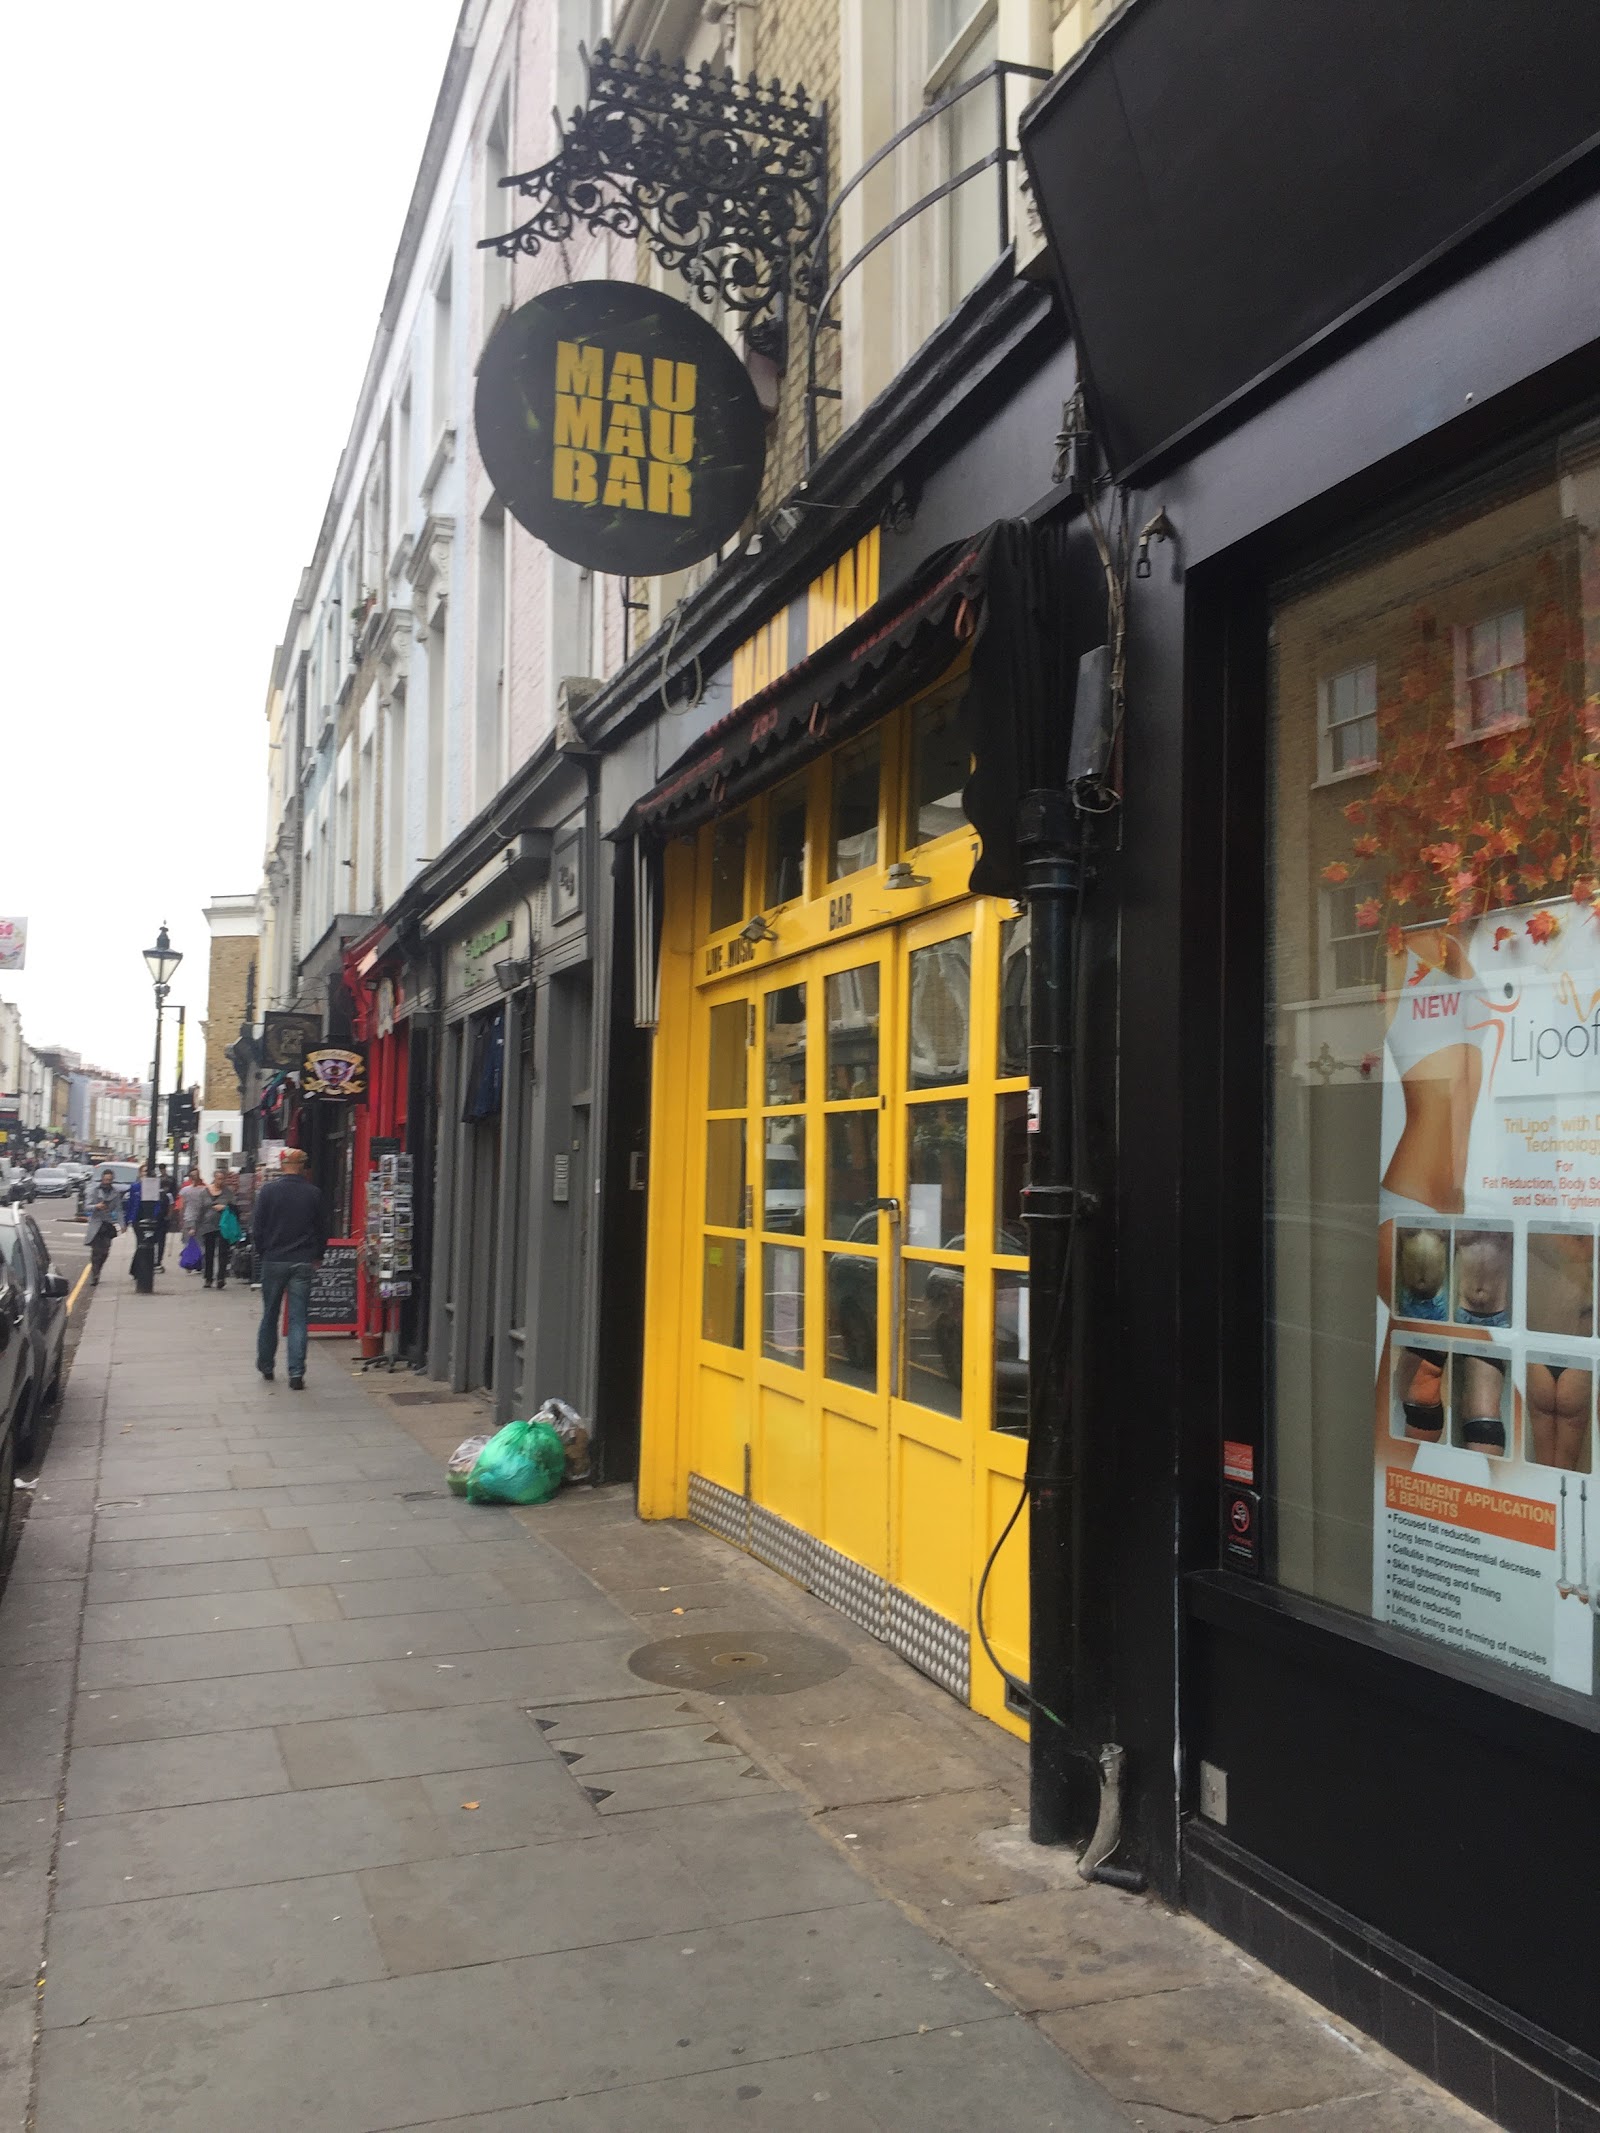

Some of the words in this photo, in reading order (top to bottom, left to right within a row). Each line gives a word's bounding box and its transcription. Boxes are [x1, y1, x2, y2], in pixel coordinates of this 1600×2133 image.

[556, 341, 697, 412] MAU
[553, 393, 695, 464] MAU
[552, 447, 692, 517] BAR
[829, 893, 852, 931] BAR
[1412, 992, 1460, 1020] NEW
[1562, 1115, 1590, 1131] with
[1525, 1136, 1600, 1155] Technolog
[1556, 1159, 1573, 1172] For
[1482, 1176, 1499, 1188] Fat
[1501, 1176, 1557, 1191] Reduction,
[1559, 1176, 1586, 1192] Body
[1512, 1194, 1531, 1206] and
[1534, 1193, 1558, 1207] Skin
[1387, 1488, 1397, 1502] &
[1400, 1491, 1458, 1518] BENEFITS
[1388, 1472, 1461, 1502] TREATMENT
[1464, 1491, 1555, 1526] APPLICATION
[1393, 1513, 1427, 1530] Focused
[1428, 1522, 1440, 1534] fat
[1441, 1528, 1481, 1545] reduction
[1392, 1543, 1424, 1561] Cellulite
[1426, 1555, 1480, 1578] improvement
[1393, 1528, 1413, 1544] Long
[1414, 1534, 1433, 1548] term
[1434, 1541, 1498, 1566] circumferential
[1499, 1559, 1542, 1579] decrease
[1392, 1558, 1410, 1572] Skin
[1411, 1565, 1451, 1587] tightening
[1453, 1579, 1469, 1590] and
[1470, 1582, 1502, 1602] firming
[1392, 1573, 1415, 1589] Facial
[1416, 1583, 1461, 1606] contouring
[1392, 1588, 1421, 1606] Wrinkle
[1422, 1601, 1462, 1620] reduction
[1420, 1613, 1446, 1632] toning
[1447, 1625, 1463, 1637] and
[1465, 1628, 1496, 1650] firming
[1497, 1641, 1507, 1651] of
[1508, 1645, 1547, 1665] muscles
